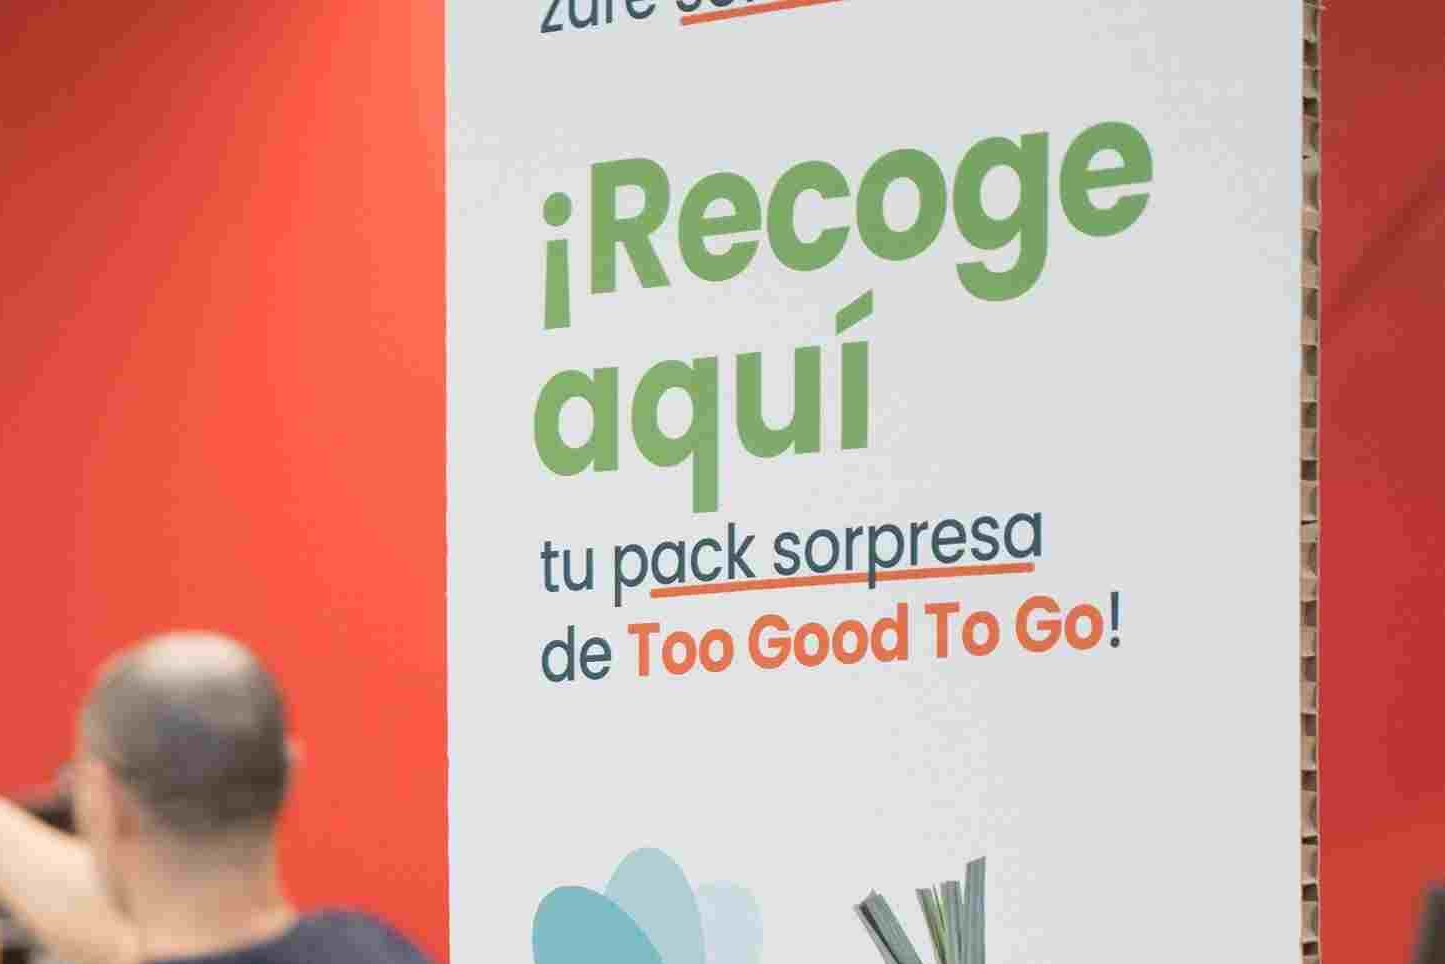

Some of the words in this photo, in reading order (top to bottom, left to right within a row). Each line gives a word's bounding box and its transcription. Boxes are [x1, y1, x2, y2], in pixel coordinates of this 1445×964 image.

[544, 121, 1154, 331] ¡Recoge
[533, 289, 876, 514] aquí
[541, 541, 595, 594] tu
[615, 522, 757, 608] pack
[774, 512, 1043, 590] sorpresa
[542, 626, 612, 684] de
[628, 623, 737, 679] Too
[748, 602, 909, 671] Good
[924, 602, 1001, 660] To
[1014, 592, 1122, 655] Go!
